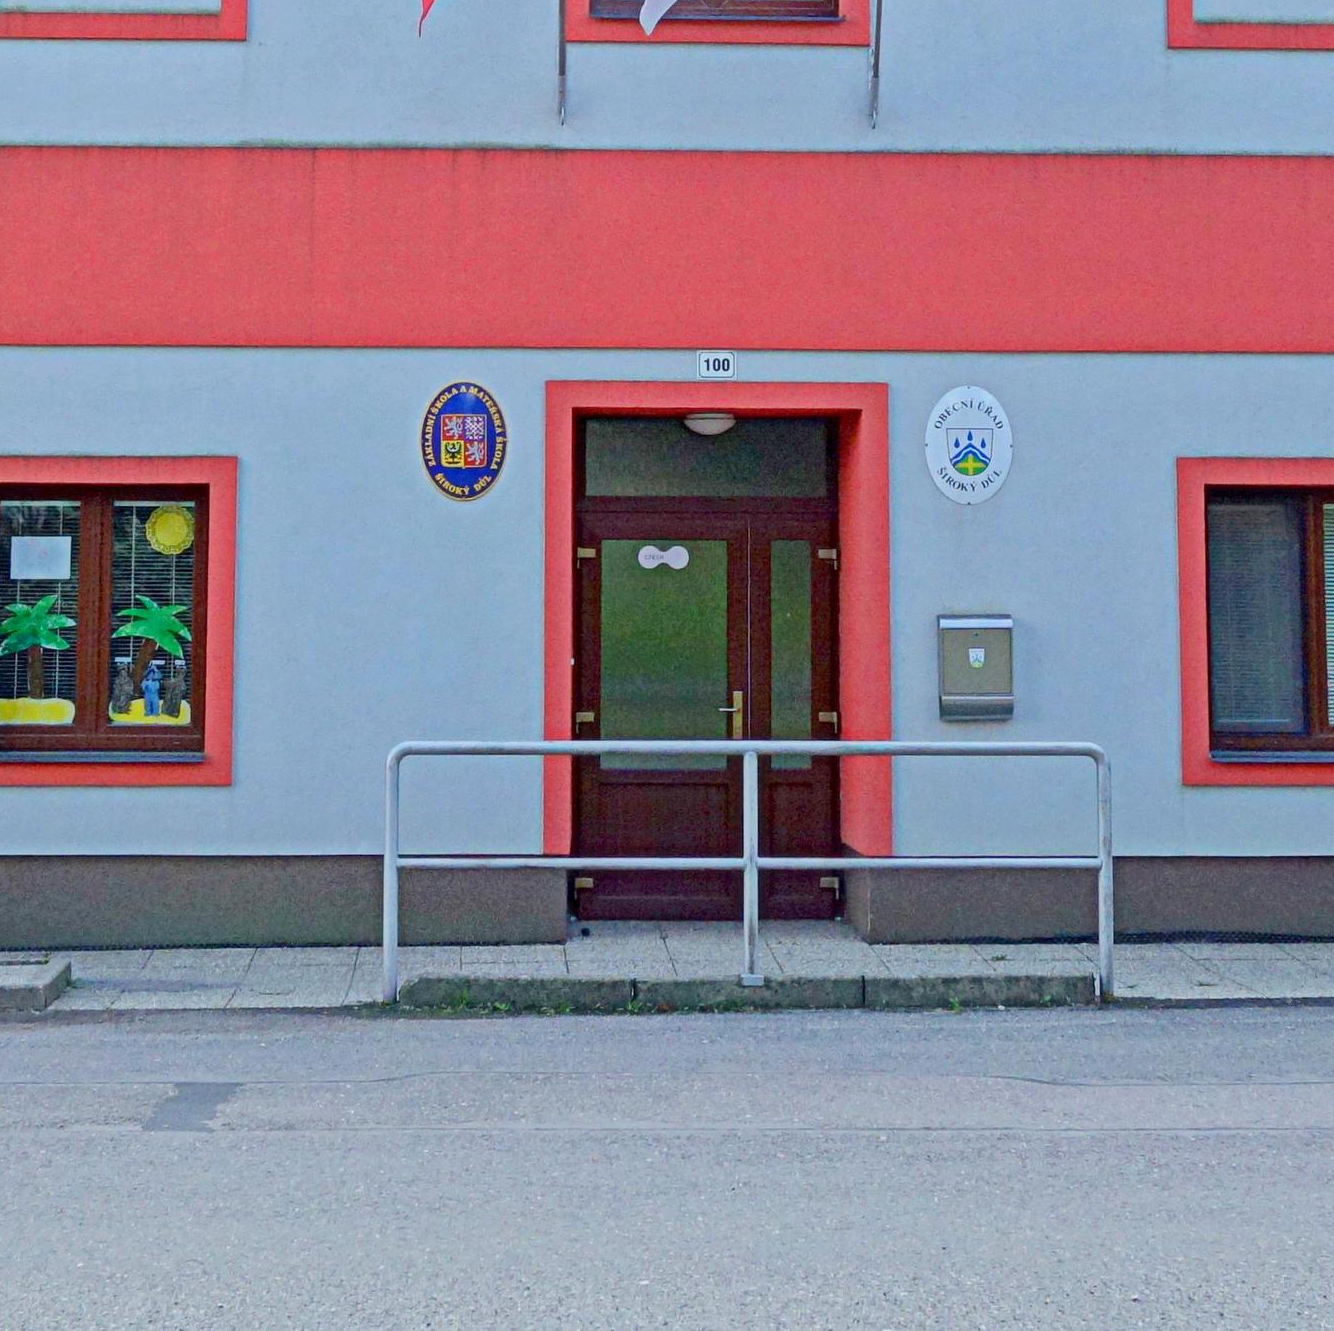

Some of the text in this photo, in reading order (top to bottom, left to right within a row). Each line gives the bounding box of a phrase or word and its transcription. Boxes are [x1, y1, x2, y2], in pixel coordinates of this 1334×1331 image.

[704, 358, 730, 372] 100
[431, 387, 458, 414] ŠKOLA
[460, 385, 468, 393] A
[934, 398, 1004, 429] OBECNÍ ÚŘAD
[434, 472, 470, 495] ŠIROKÝ
[937, 466, 978, 492] ŠIROKÝ
